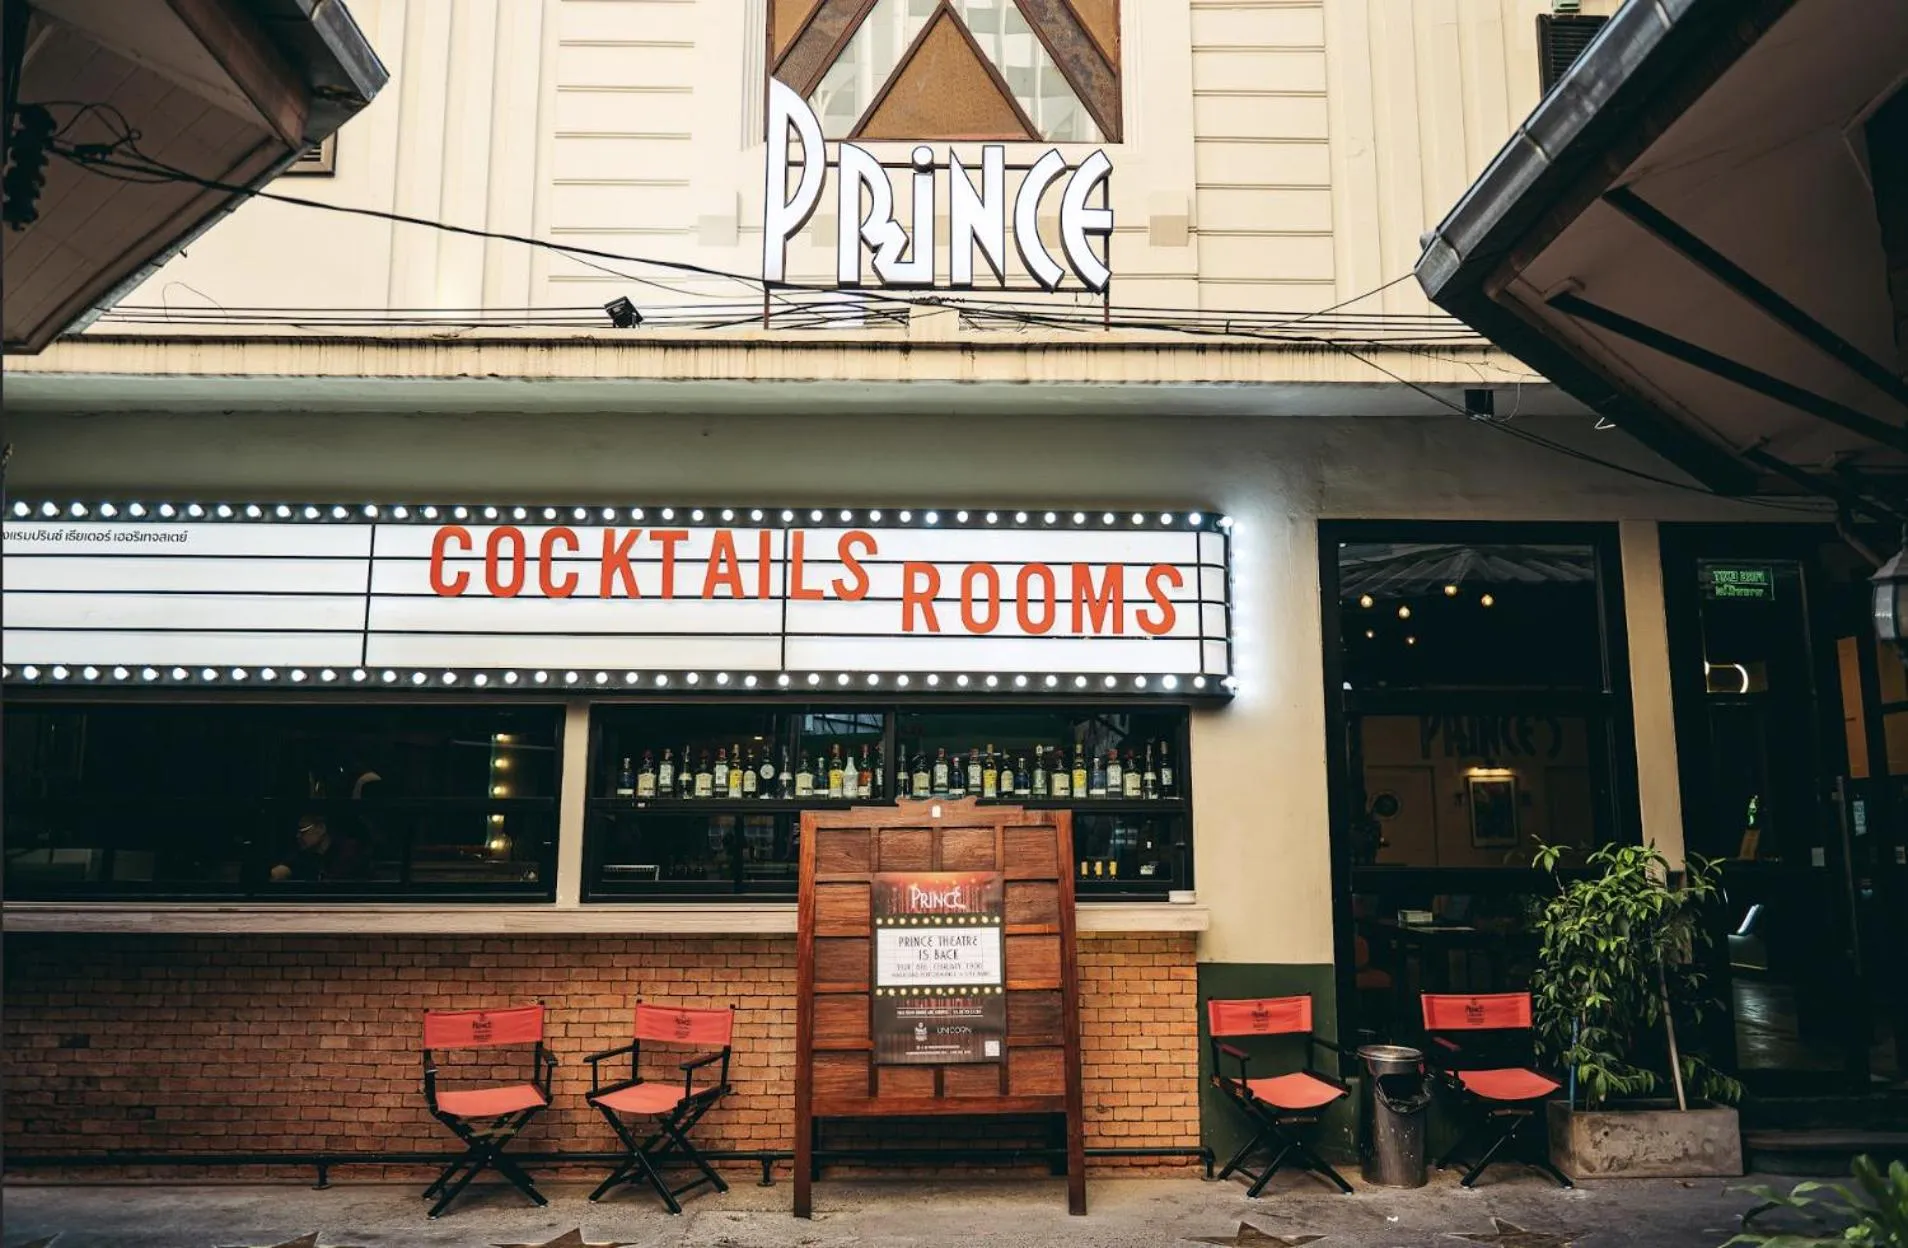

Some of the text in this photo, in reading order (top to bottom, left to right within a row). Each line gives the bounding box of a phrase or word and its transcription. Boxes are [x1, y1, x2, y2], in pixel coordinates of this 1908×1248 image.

[430, 525, 878, 600] COCKTAILS
[902, 562, 1184, 635] ROOMS
[898, 935, 978, 948] PRINCE THEATRE
[918, 948, 958, 960] IS BACK
